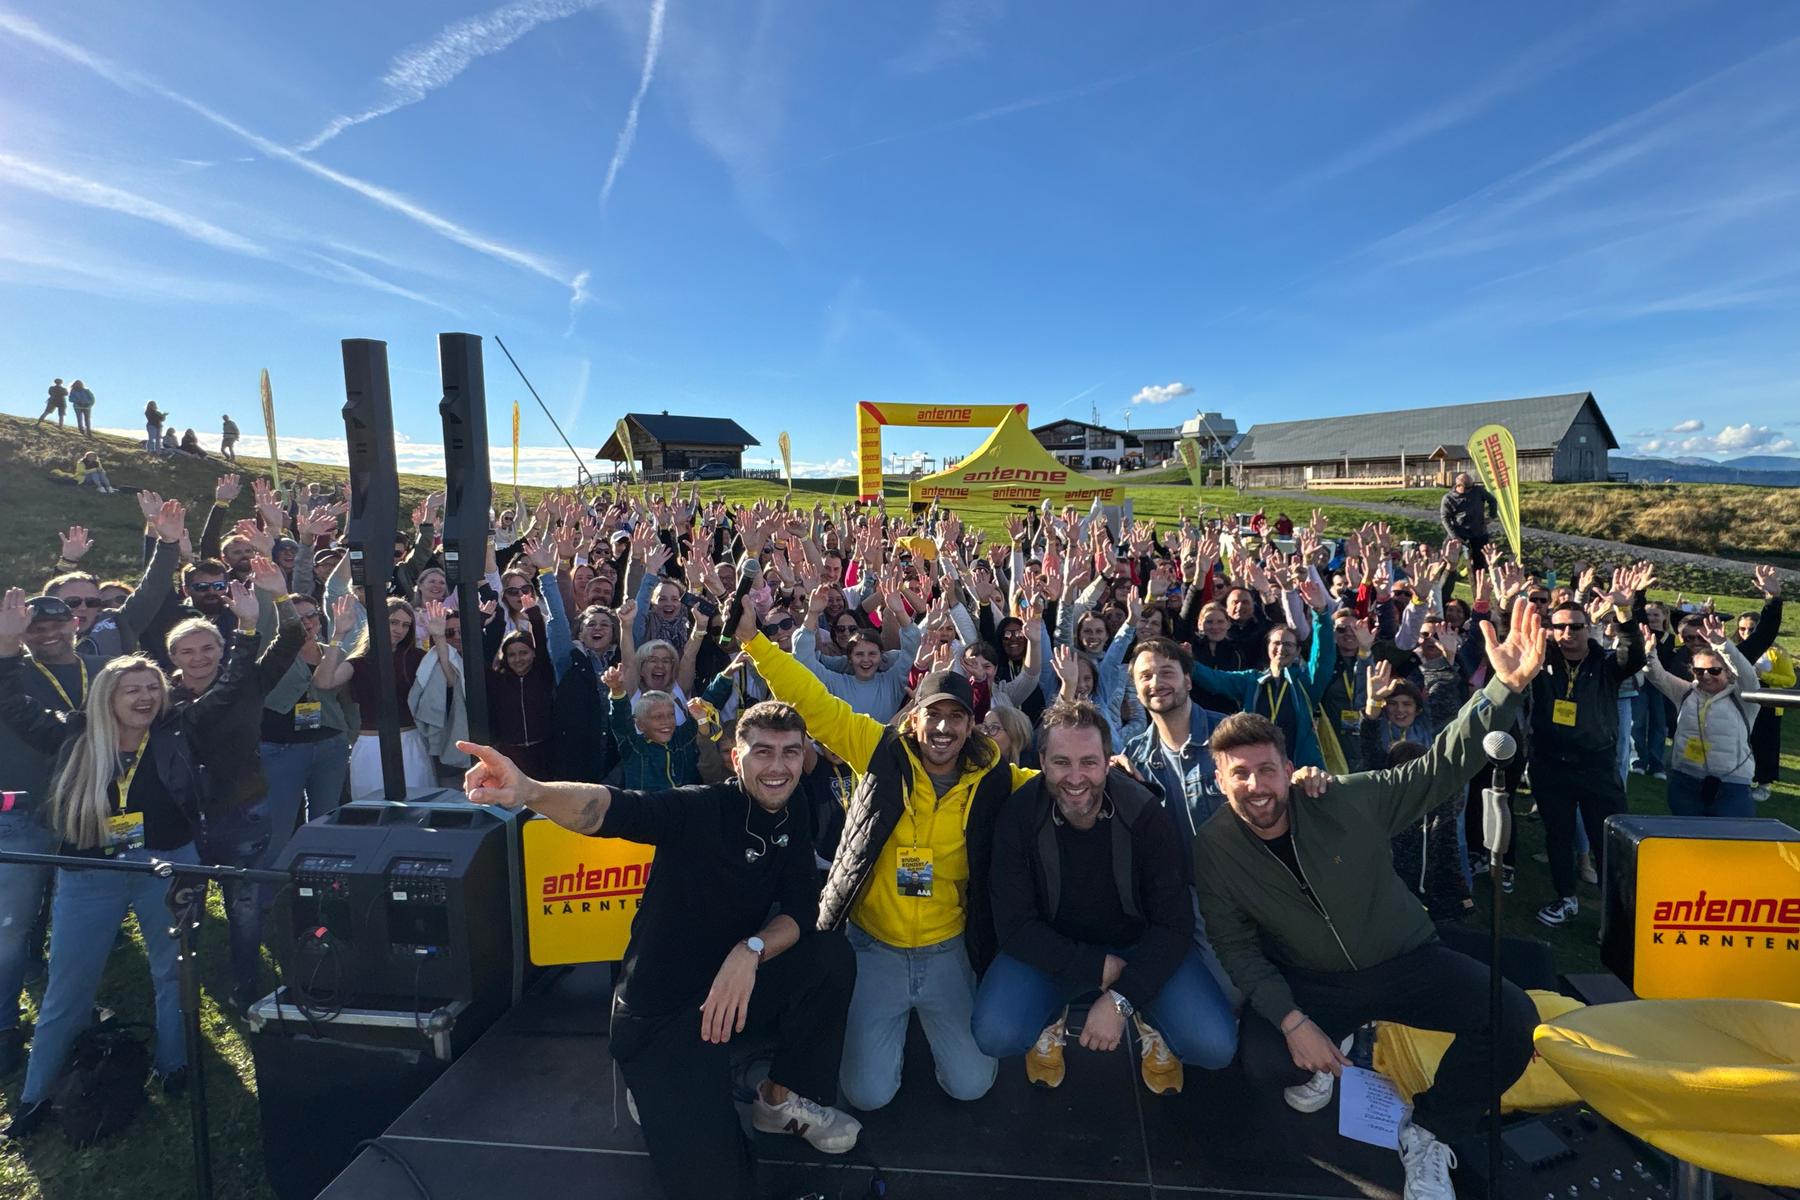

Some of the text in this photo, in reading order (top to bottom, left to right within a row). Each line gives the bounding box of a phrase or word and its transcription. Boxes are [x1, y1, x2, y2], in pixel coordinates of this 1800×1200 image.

[917, 408, 972, 420] antenne
[963, 466, 1067, 482] antenne
[921, 486, 969, 496] antenne
[993, 486, 1041, 498] antenne
[1064, 488, 1113, 499] antenne
[1653, 890, 1800, 924] antenne
[1653, 931, 1799, 951] KÄRNTEN
